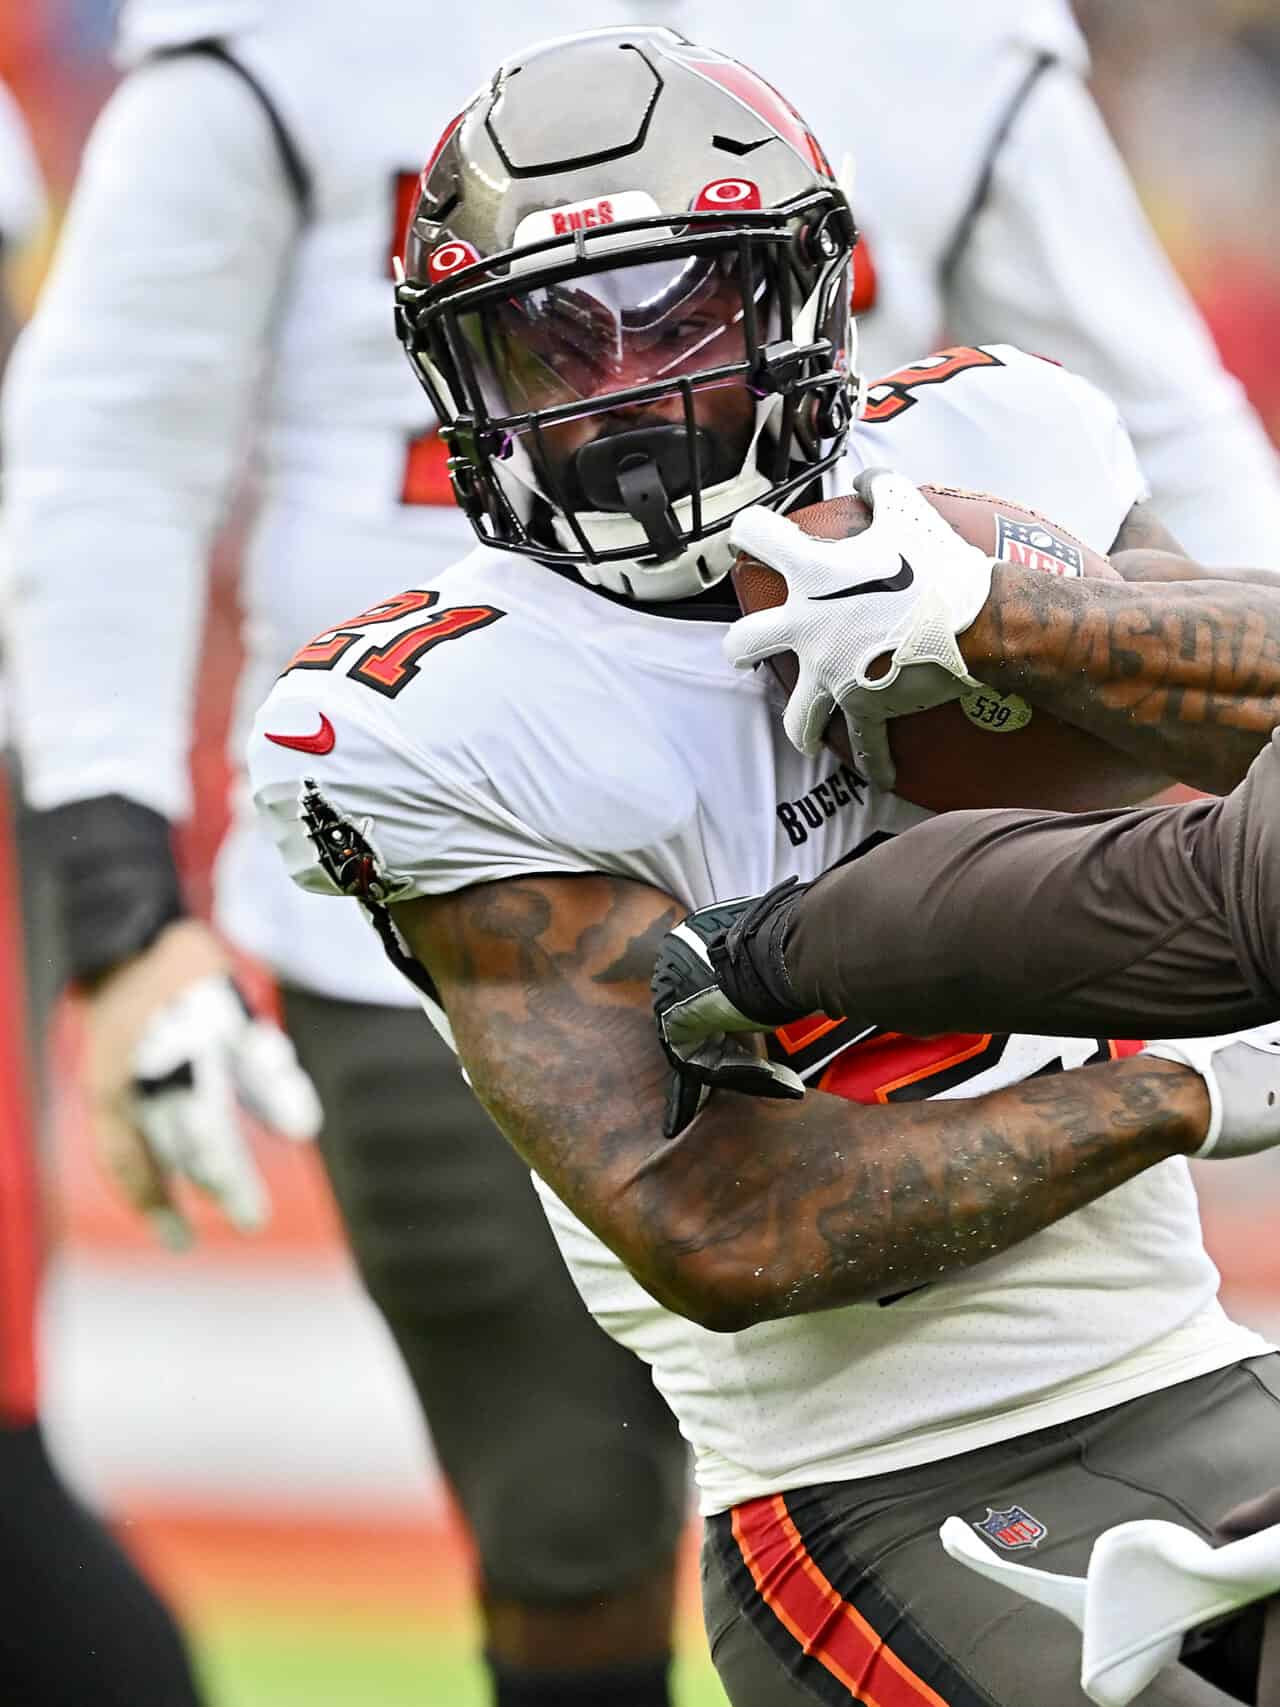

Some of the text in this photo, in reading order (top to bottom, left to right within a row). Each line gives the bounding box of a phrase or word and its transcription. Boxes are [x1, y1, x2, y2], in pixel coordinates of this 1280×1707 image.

[276, 590, 508, 700] 21
[970, 696, 1011, 728] 539
[995, 1521, 1039, 1547] NFL
